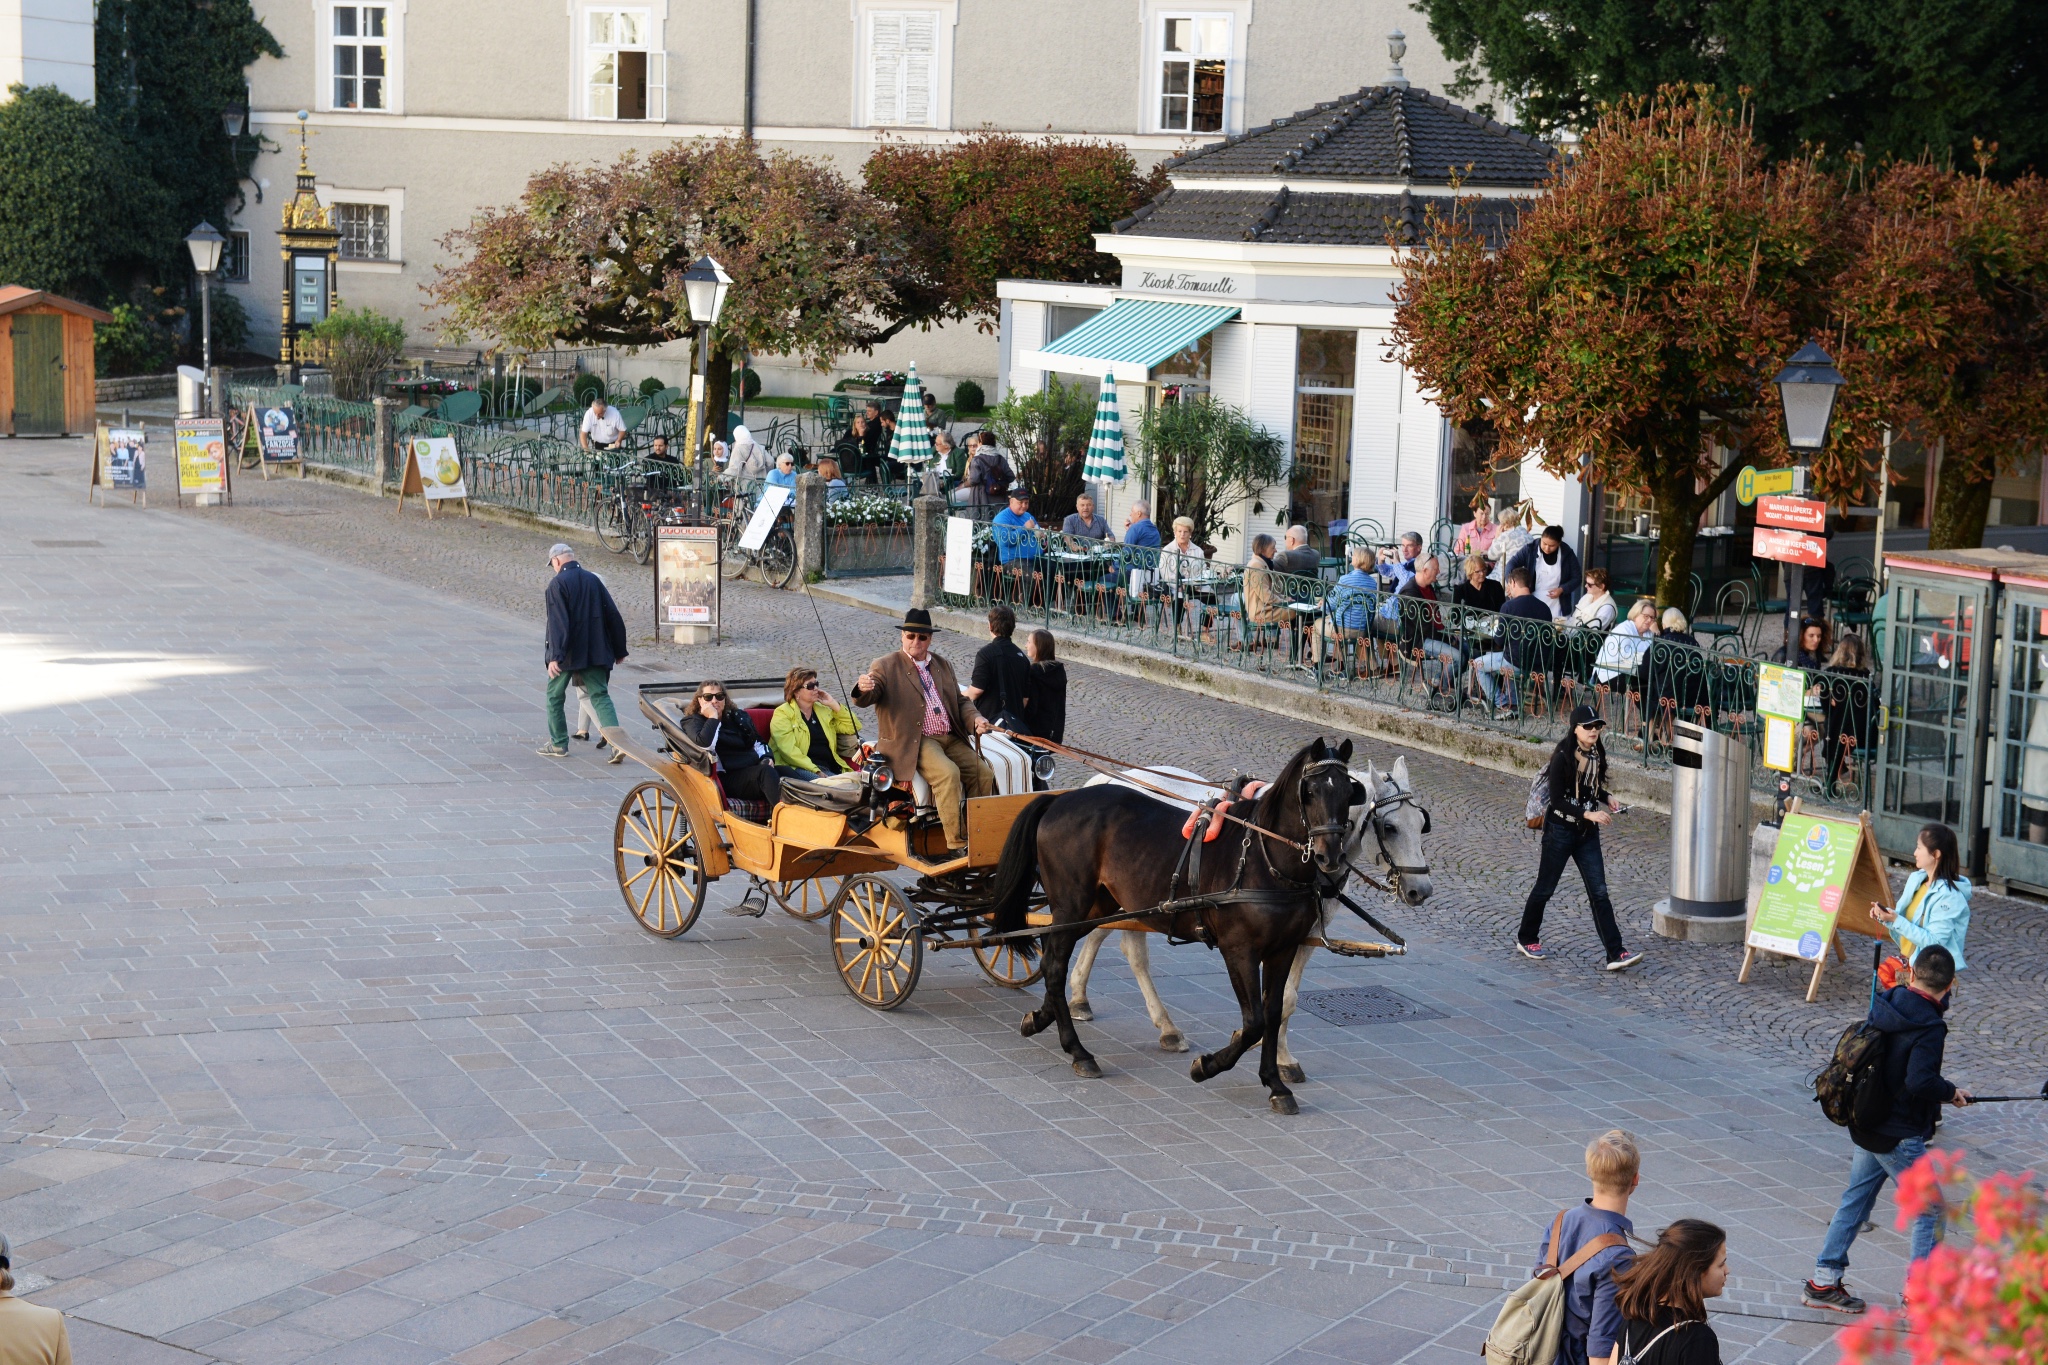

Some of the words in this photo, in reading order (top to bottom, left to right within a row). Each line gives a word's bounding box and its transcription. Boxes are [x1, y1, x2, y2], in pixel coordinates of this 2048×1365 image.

[1138, 271, 1175, 290] Kiosk
[1175, 273, 1237, 294] Tomaselli
[1743, 474, 1754, 498] H
[1769, 503, 1789, 512] MARKUS
[1790, 504, 1813, 515] LÜPERTZ
[1769, 537, 1790, 546] ANSELM
[1791, 541, 1807, 549] KIEFE
[1796, 856, 1824, 872] Lesen
